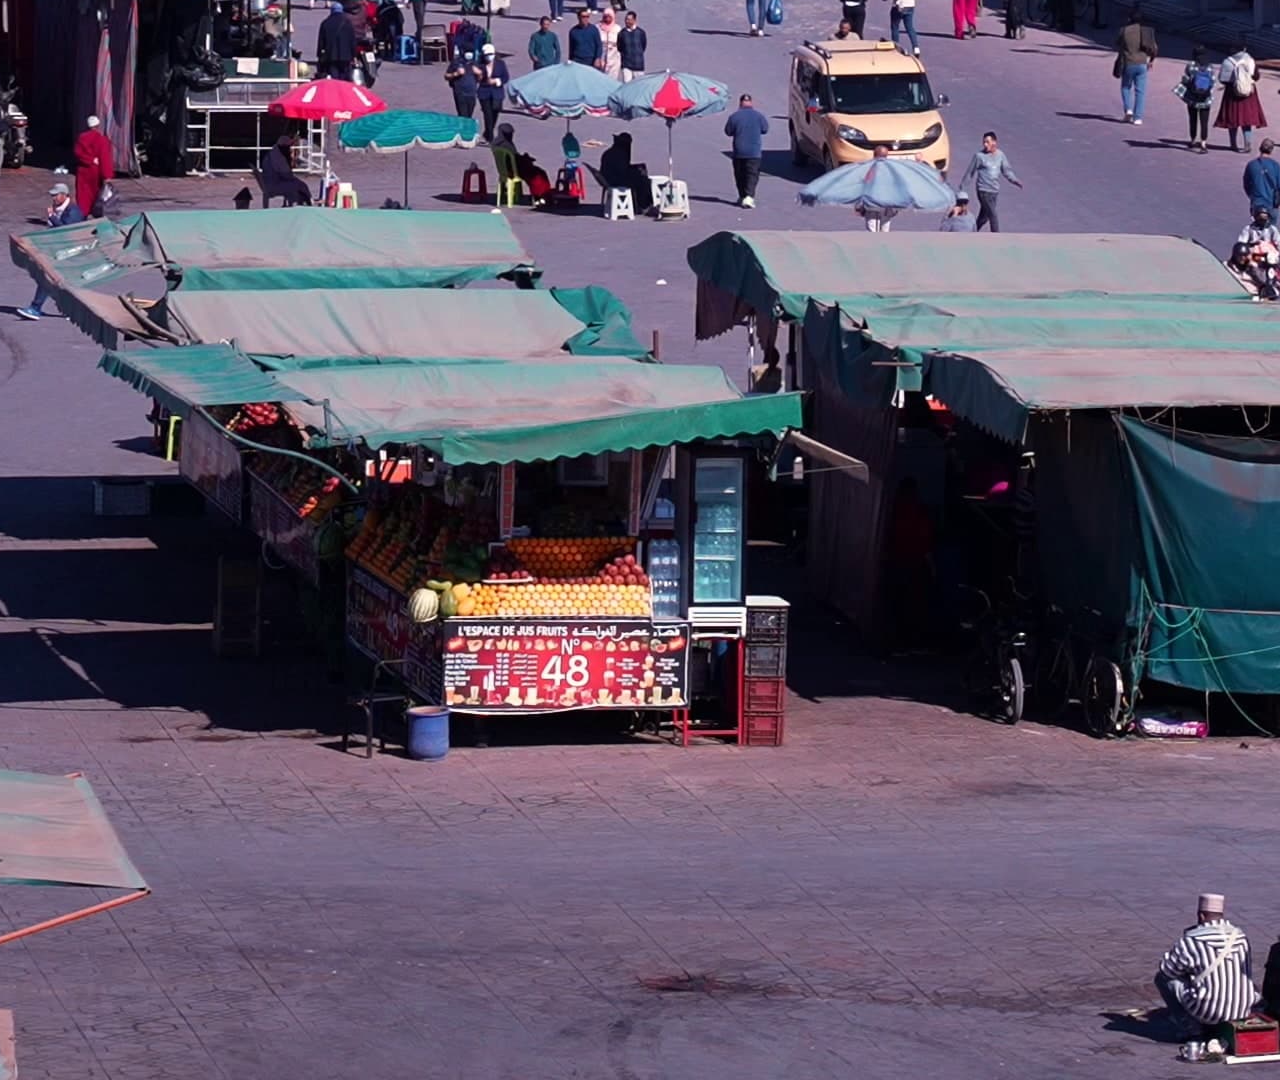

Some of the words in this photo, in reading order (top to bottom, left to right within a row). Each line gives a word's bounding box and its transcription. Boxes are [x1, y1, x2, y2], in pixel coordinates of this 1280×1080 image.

[458, 625, 501, 637] L'ESPACE
[503, 625, 516, 637] DE
[517, 625, 535, 637] JUS
[536, 625, 568, 637] FRUITS
[540, 654, 590, 687] 48
